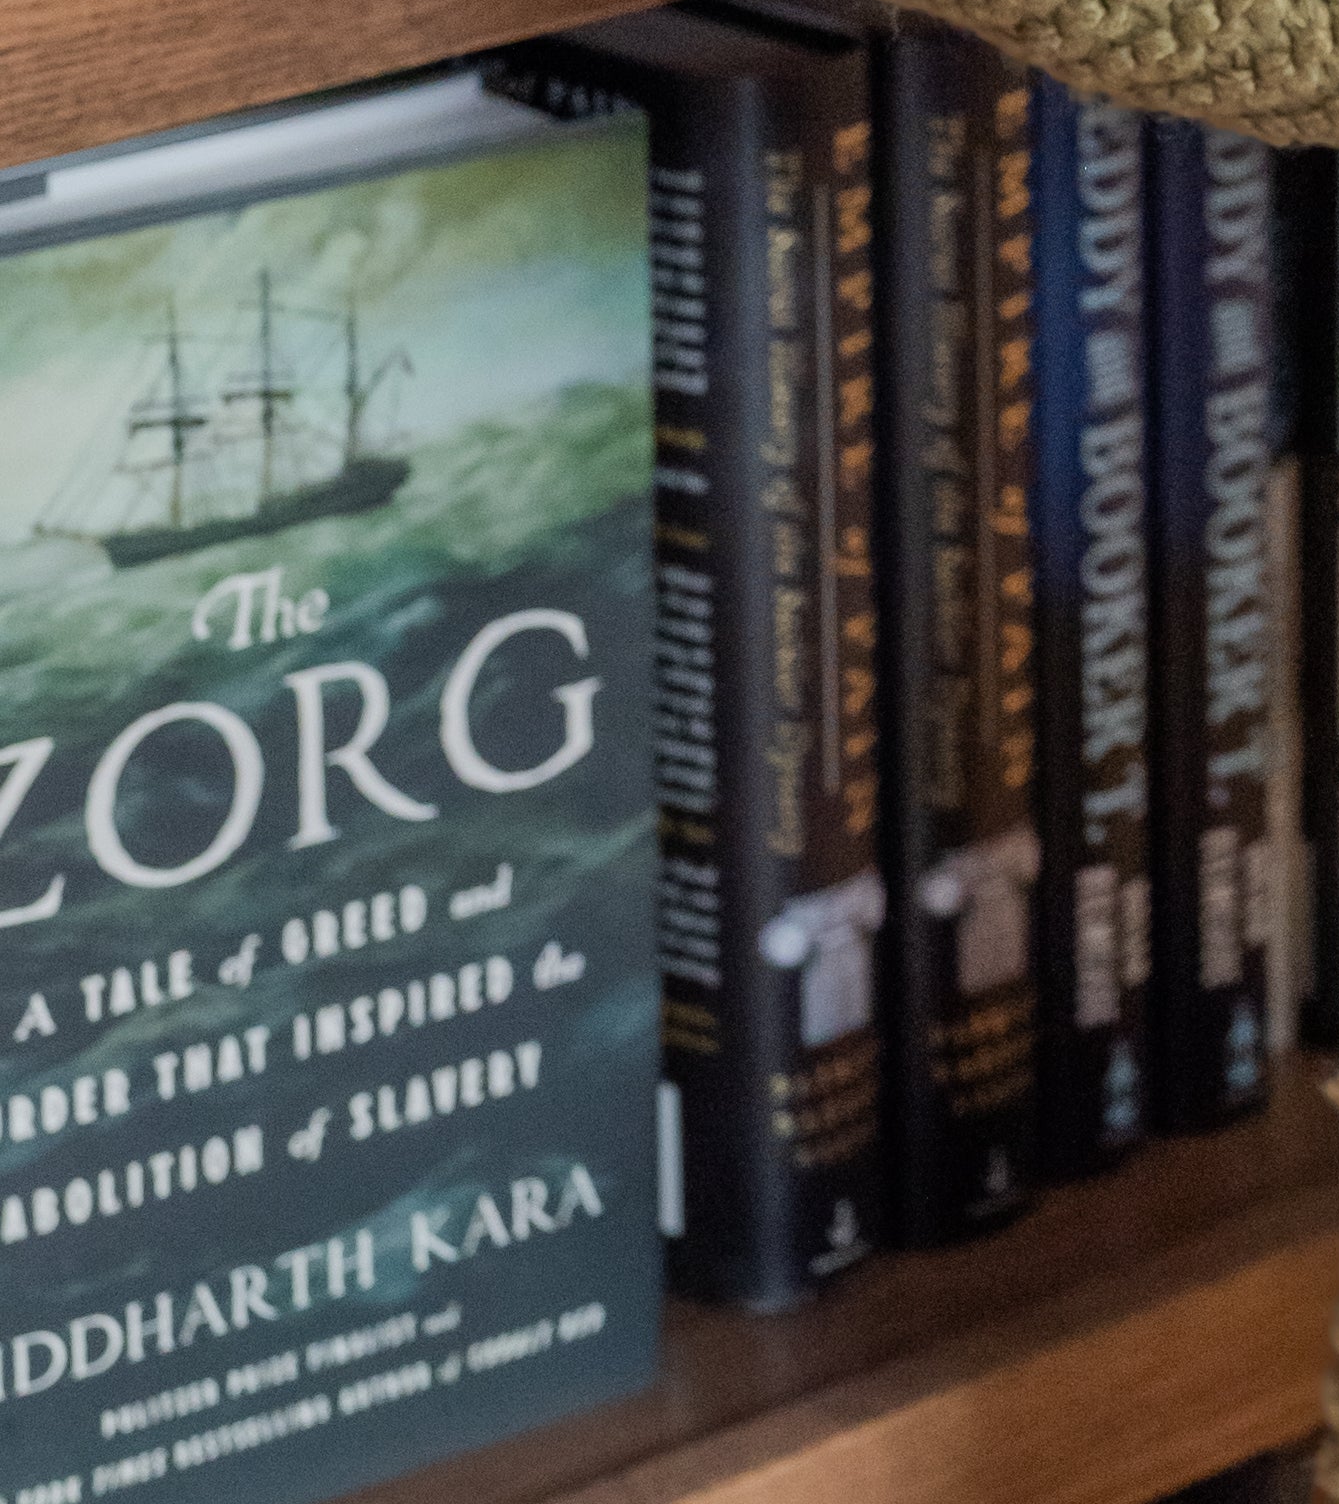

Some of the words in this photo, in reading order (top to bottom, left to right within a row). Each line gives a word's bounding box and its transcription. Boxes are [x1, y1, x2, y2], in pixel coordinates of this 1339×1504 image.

[1080, 105, 1146, 315] EDDY
[191, 566, 331, 651] The
[1080, 414, 1150, 760] BOOKER
[0, 608, 601, 926] ZORG
[0, 1067, 132, 1144] RDER
[153, 1024, 271, 1101] THAT
[292, 954, 515, 1062] INSPIRED
[12, 993, 56, 1043] A
[81, 949, 194, 1023] TALE
[218, 933, 263, 990] of
[281, 884, 428, 966] GREED
[448, 862, 514, 921] and
[0, 1124, 265, 1246] ABOLITION
[287, 1106, 333, 1161] of
[347, 1039, 544, 1142] SLAVERY
[0, 1227, 376, 1402] DDHARTH
[409, 1163, 605, 1273] KARA
